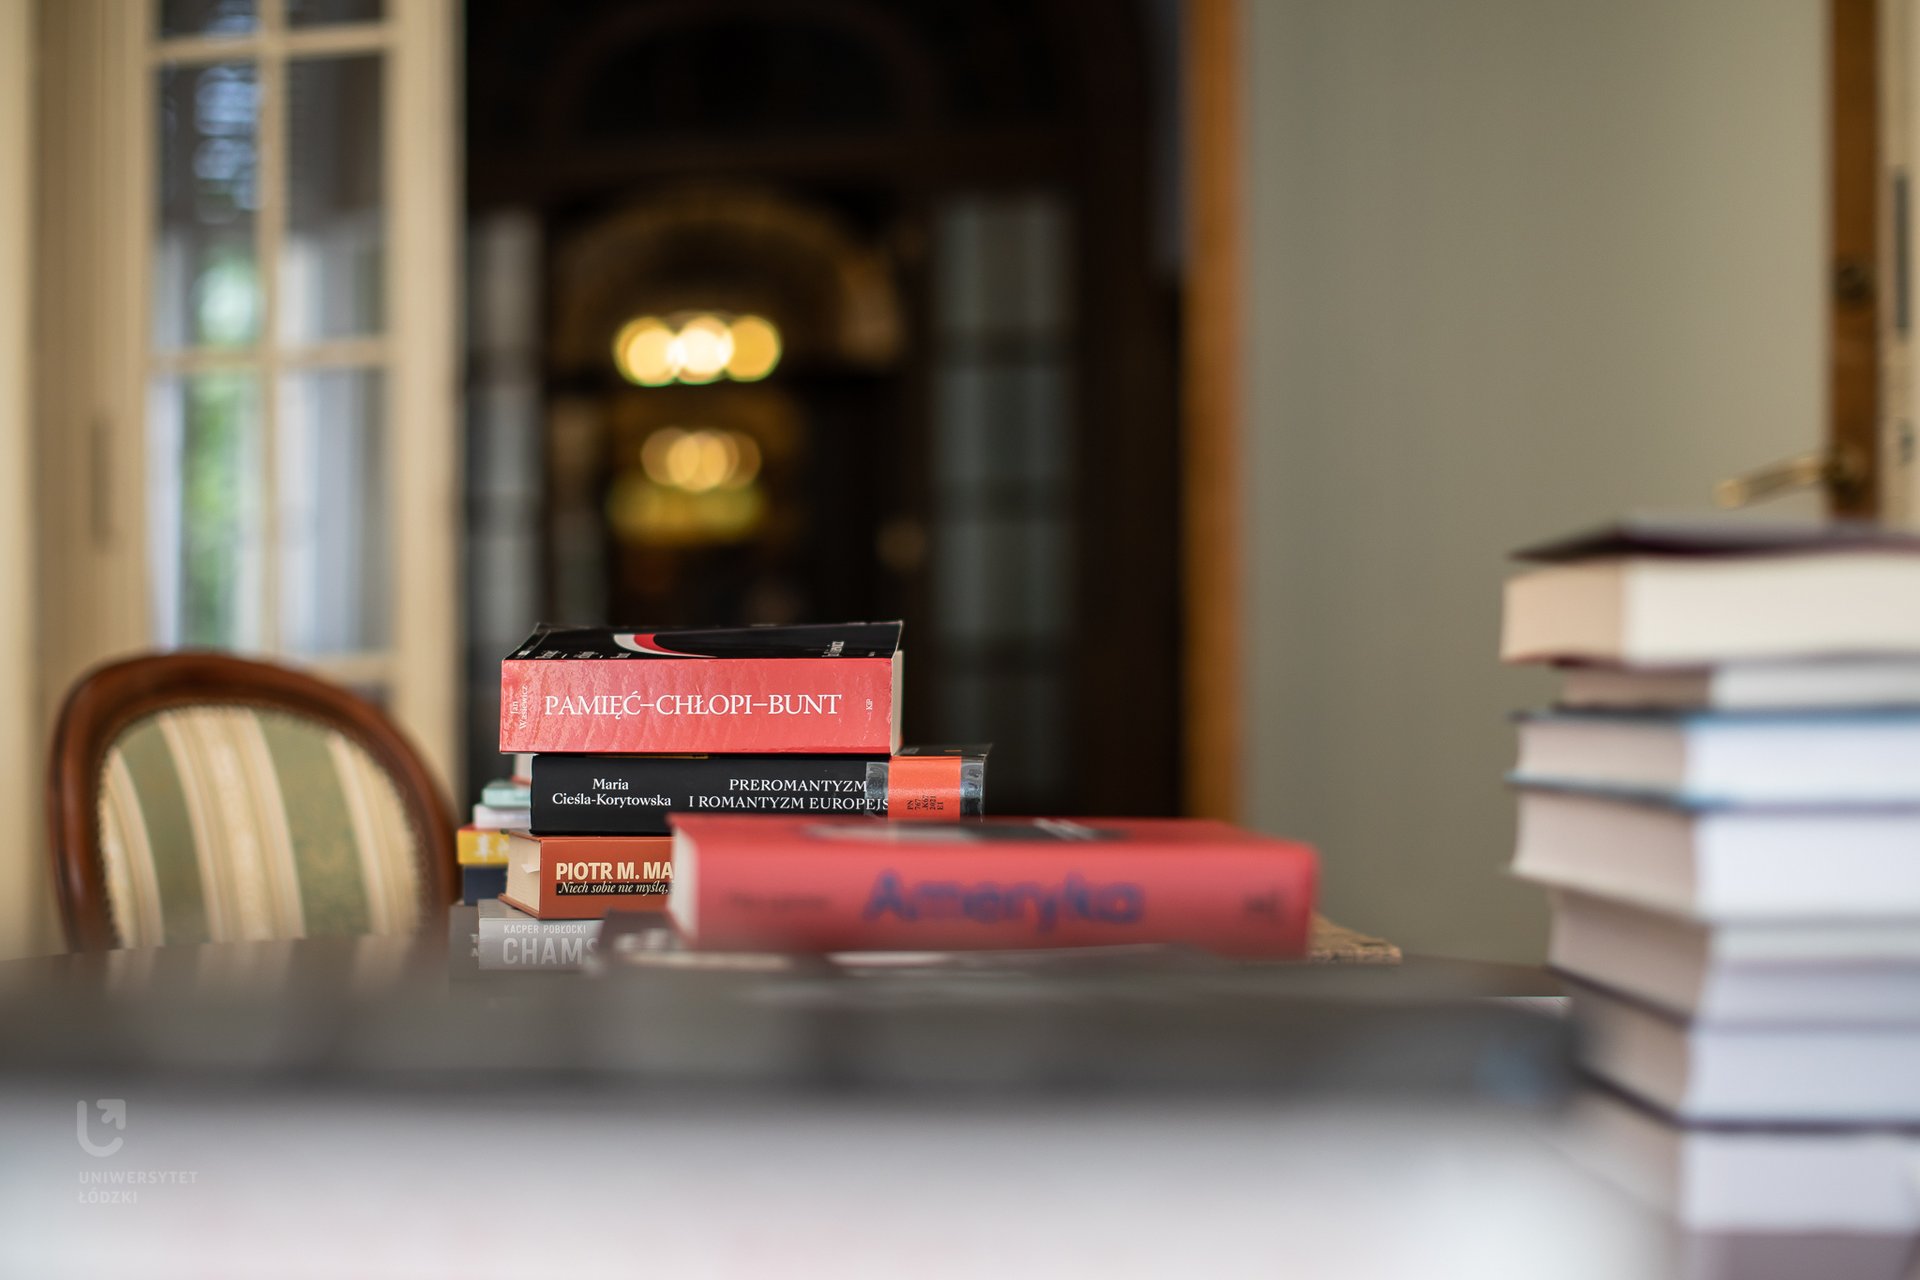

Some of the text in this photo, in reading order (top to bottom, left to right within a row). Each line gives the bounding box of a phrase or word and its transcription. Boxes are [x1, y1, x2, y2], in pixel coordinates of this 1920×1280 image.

[592, 778, 629, 790] Maria
[729, 778, 867, 793] PREROMANTYZM
[552, 792, 672, 808] Cieśla-Korytowska
[688, 795, 694, 808] I
[698, 795, 805, 809] ROMANTYZM
[556, 861, 674, 880] PIOTR M. MA
[558, 880, 669, 897] Niech sobie nie myślą,
[503, 924, 586, 934] KACPER POBŁOCKI
